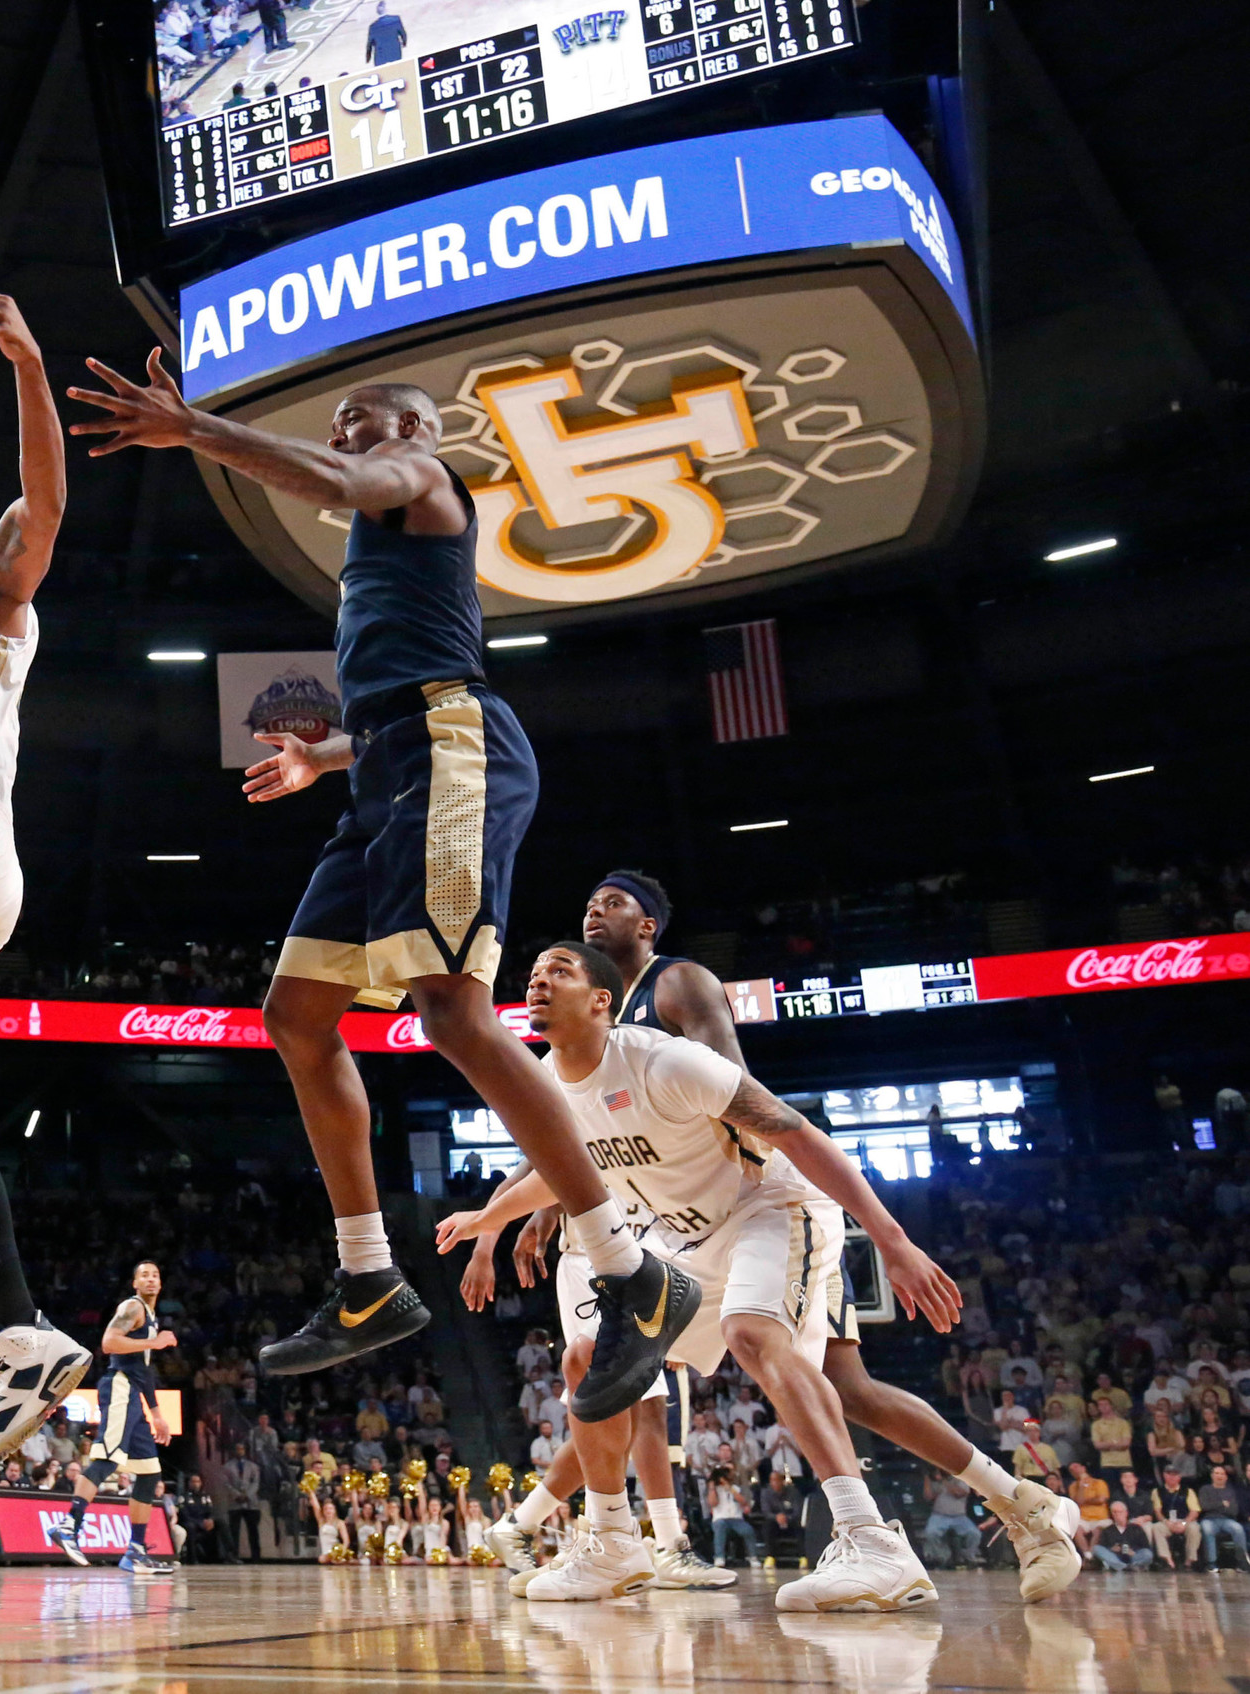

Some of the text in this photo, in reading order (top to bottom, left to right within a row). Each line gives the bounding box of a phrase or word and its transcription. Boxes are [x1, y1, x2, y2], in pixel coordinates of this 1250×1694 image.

[659, 13, 674, 35] 6
[696, 5, 716, 24] 3P
[776, 6, 788, 22] 3
[779, 9, 841, 39] 4 1 0
[553, 10, 627, 55] PITT
[700, 19, 763, 50] FT 66.7
[778, 27, 844, 58] 15 0 0
[460, 39, 496, 62] POSS
[648, 40, 691, 64] BONUS
[705, 46, 767, 76] REB 6
[501, 55, 530, 84] 22
[653, 65, 695, 90] TOL 4
[289, 90, 317, 106] TEAM
[340, 74, 405, 112] GT
[431, 73, 466, 101] 1ST
[229, 101, 281, 129] FG 35.7
[289, 100, 322, 118] FOULS
[443, 89, 535, 145] 11:16
[164, 117, 223, 142] PLR FL PTS
[300, 114, 313, 136] 2
[171, 130, 221, 156] 0 0 2
[230, 125, 284, 153] 3P 0.0
[290, 138, 329, 163] BONUS
[350, 109, 406, 170] 14
[173, 146, 223, 171] 1 0 2
[232, 150, 285, 178] FT 66.7
[174, 161, 224, 188] 2 1 2
[293, 164, 329, 186] TOL 4
[175, 177, 225, 203] 3 0 4
[234, 175, 288, 203] REB 9
[173, 193, 227, 220] 32 0 3
[180, 176, 668, 374] APOWER.COM
[277, 719, 316, 732] 1990
[1066, 939, 1250, 988] Coca-Cola ze
[802, 977, 830, 991] POSS
[734, 995, 760, 1021] 14
[783, 993, 832, 1019] 11:16
[843, 995, 861, 1008] 1ST
[119, 1006, 268, 1043] Coca-Cola zer
[586, 1135, 661, 1170] ORGIA
[661, 1206, 711, 1234] CH
[38, 1510, 132, 1548] NSSAN
